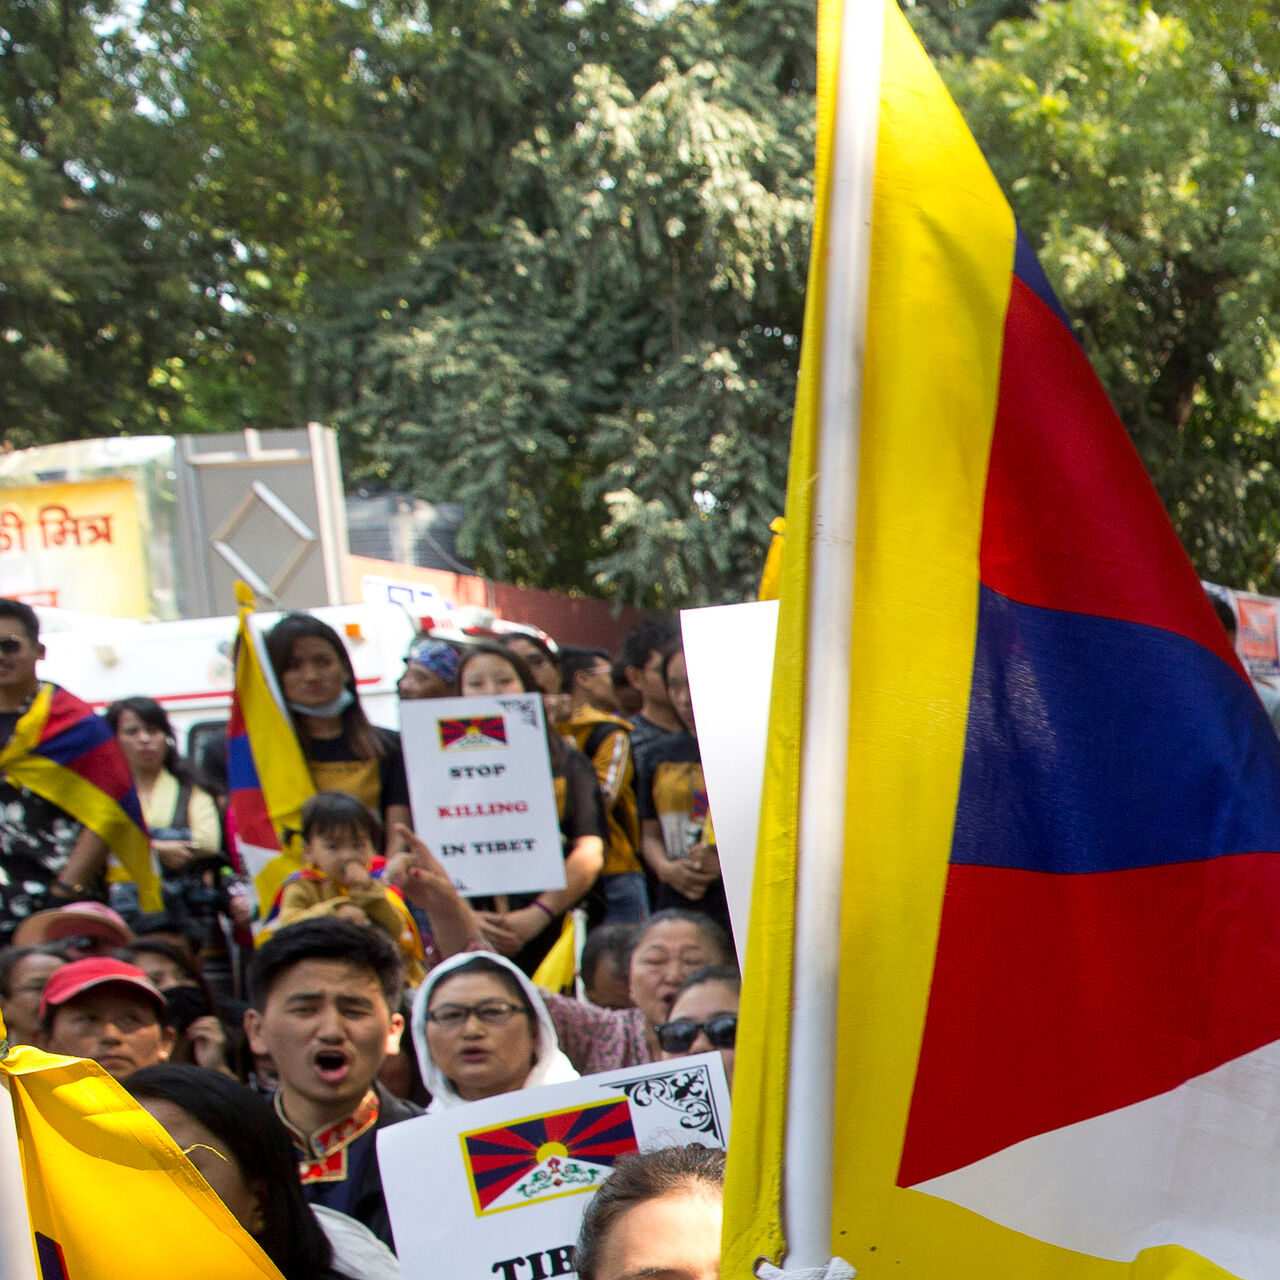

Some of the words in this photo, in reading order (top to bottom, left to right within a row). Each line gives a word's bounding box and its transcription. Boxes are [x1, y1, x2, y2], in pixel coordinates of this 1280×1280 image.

[40, 505, 112, 547] मित्र
[449, 765, 505, 779] STOP
[438, 801, 528, 819] KILLING
[441, 845, 466, 857] IN
[471, 838, 536, 854] TIBET
